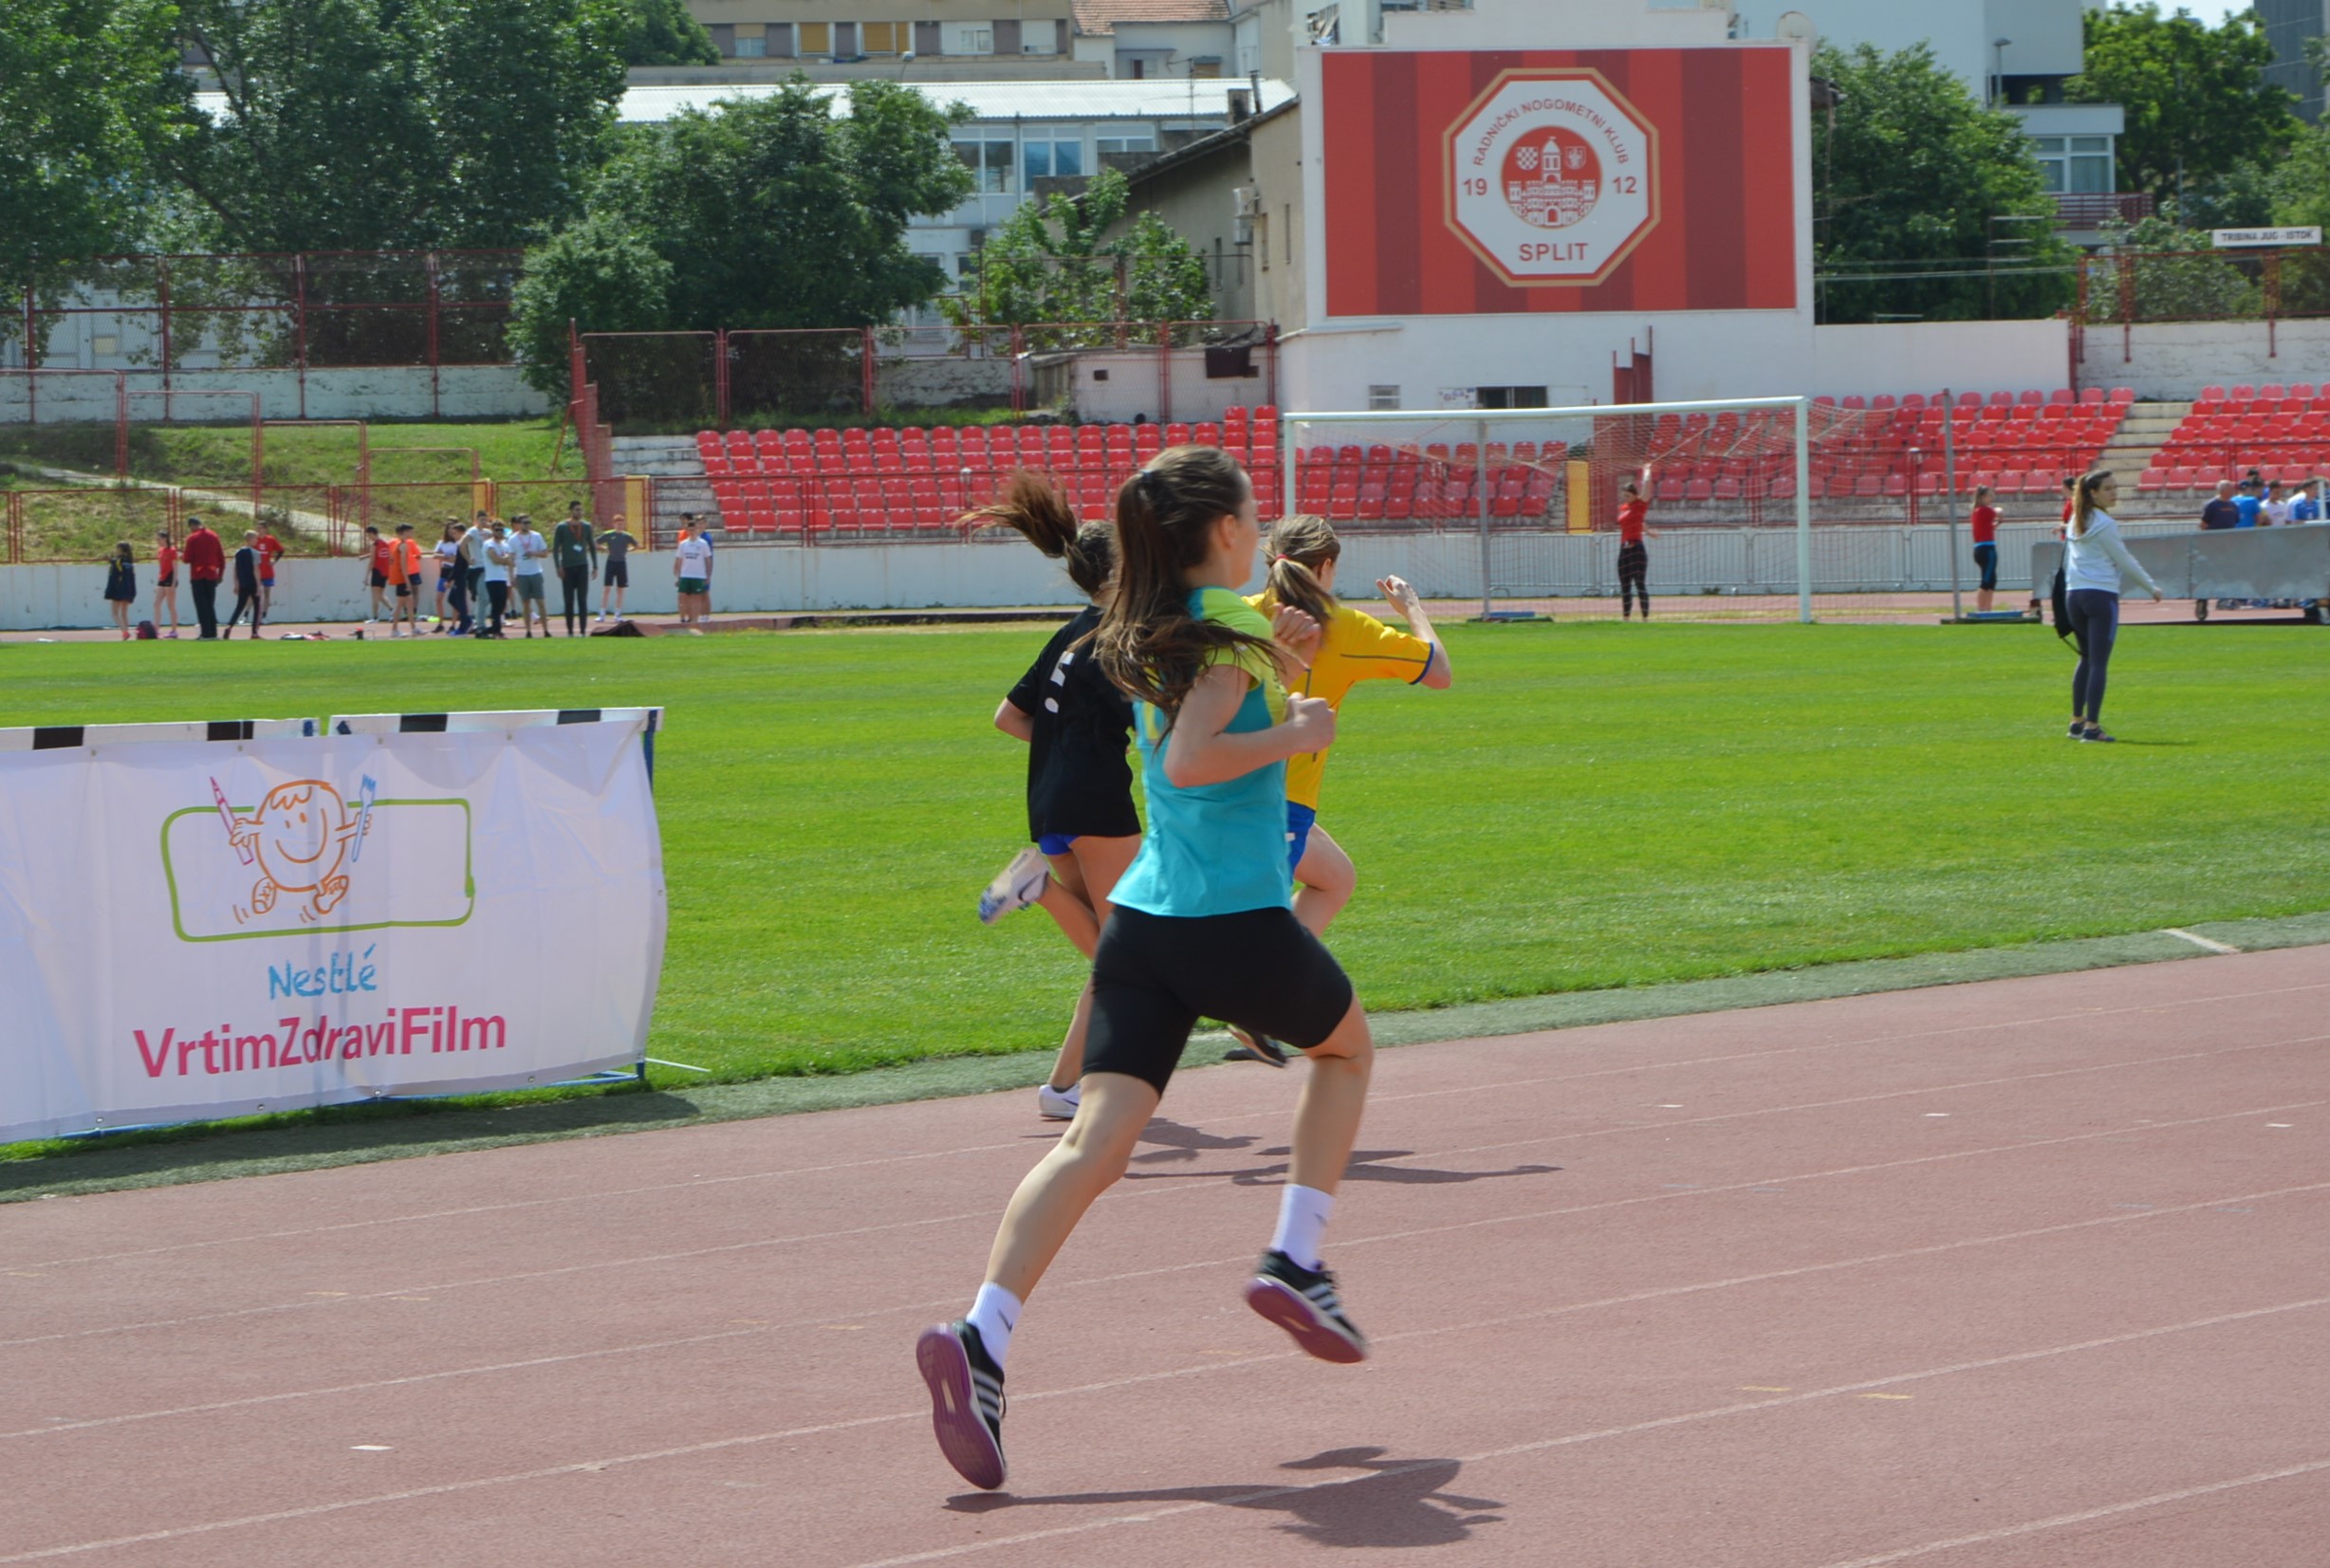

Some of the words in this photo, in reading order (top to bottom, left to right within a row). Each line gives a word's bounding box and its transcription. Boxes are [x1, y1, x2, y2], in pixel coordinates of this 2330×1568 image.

[1473, 108, 1520, 166] RADNIČKI
[1522, 99, 1605, 128] NOGOMETNI
[1603, 126, 1630, 164] KLUB
[1463, 177, 1488, 196] 19
[1613, 175, 1637, 194] 12
[1519, 243, 1588, 262] SPLIT
[268, 944, 377, 1000] Nestlé
[133, 1005, 507, 1079] VrtimZdraviFilm
